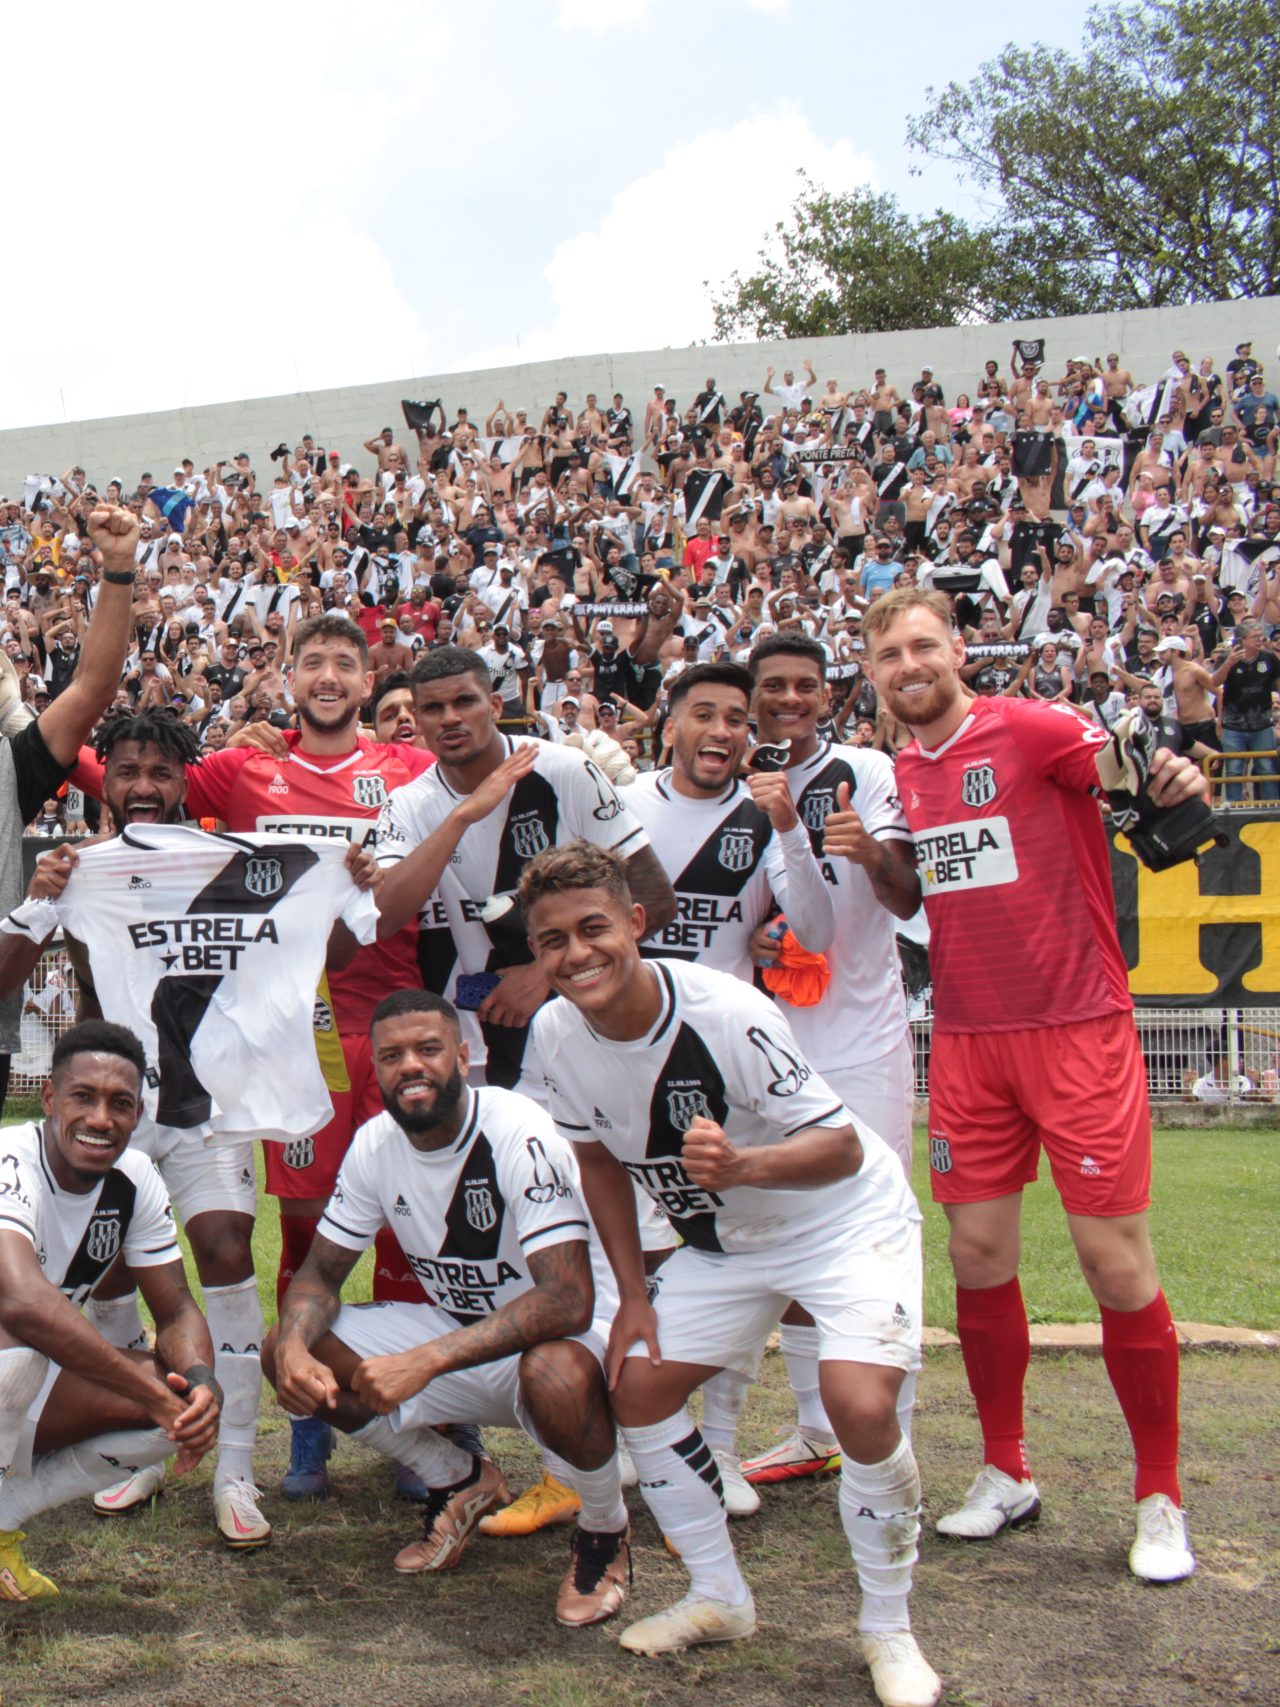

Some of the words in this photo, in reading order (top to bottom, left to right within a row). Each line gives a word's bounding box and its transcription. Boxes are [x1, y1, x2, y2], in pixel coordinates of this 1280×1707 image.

[800, 450, 828, 460] PONTE
[830, 448, 856, 459] PRETA
[964, 644, 1029, 656] ONTERROR
[269, 785, 289, 795] 1900
[916, 828, 1000, 862] STRELA
[935, 857, 976, 884] BET
[677, 898, 743, 923] RELA
[128, 918, 279, 949] ESTRELA
[662, 922, 718, 948] BET
[183, 945, 246, 971] BET
[593, 1118, 613, 1130] 1900
[394, 1206, 412, 1217] 1900
[658, 1187, 725, 1215] BET
[406, 1254, 523, 1289] ESTRELA
[446, 1286, 497, 1312] BET
[892, 1316, 911, 1329] 1900
